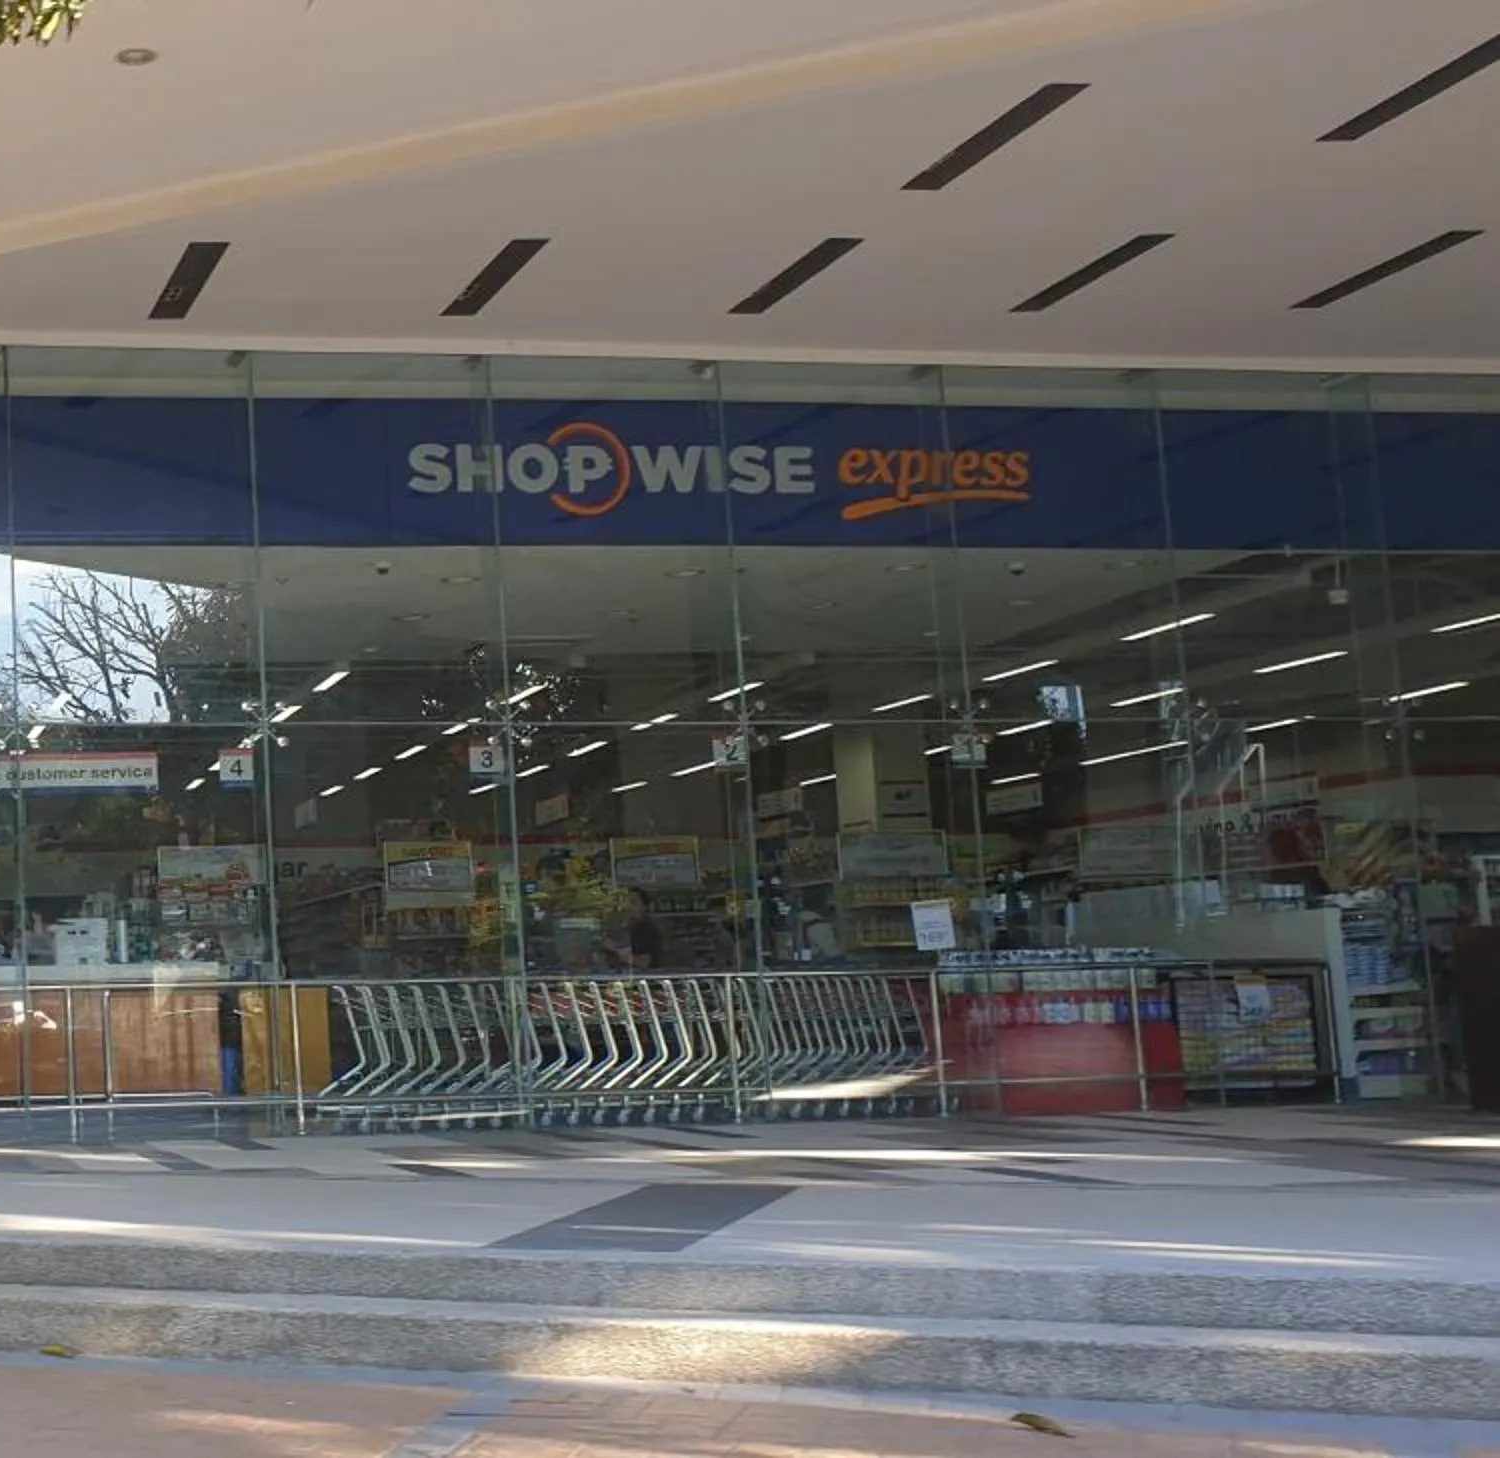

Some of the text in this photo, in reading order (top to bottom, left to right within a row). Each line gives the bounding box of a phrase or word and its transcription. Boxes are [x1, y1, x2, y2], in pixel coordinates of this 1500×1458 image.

[838, 445, 1030, 503] express
[480, 751, 493, 768] 3
[725, 743, 740, 761] 2
[6, 766, 153, 782] customer service
[229, 759, 243, 777] 4
